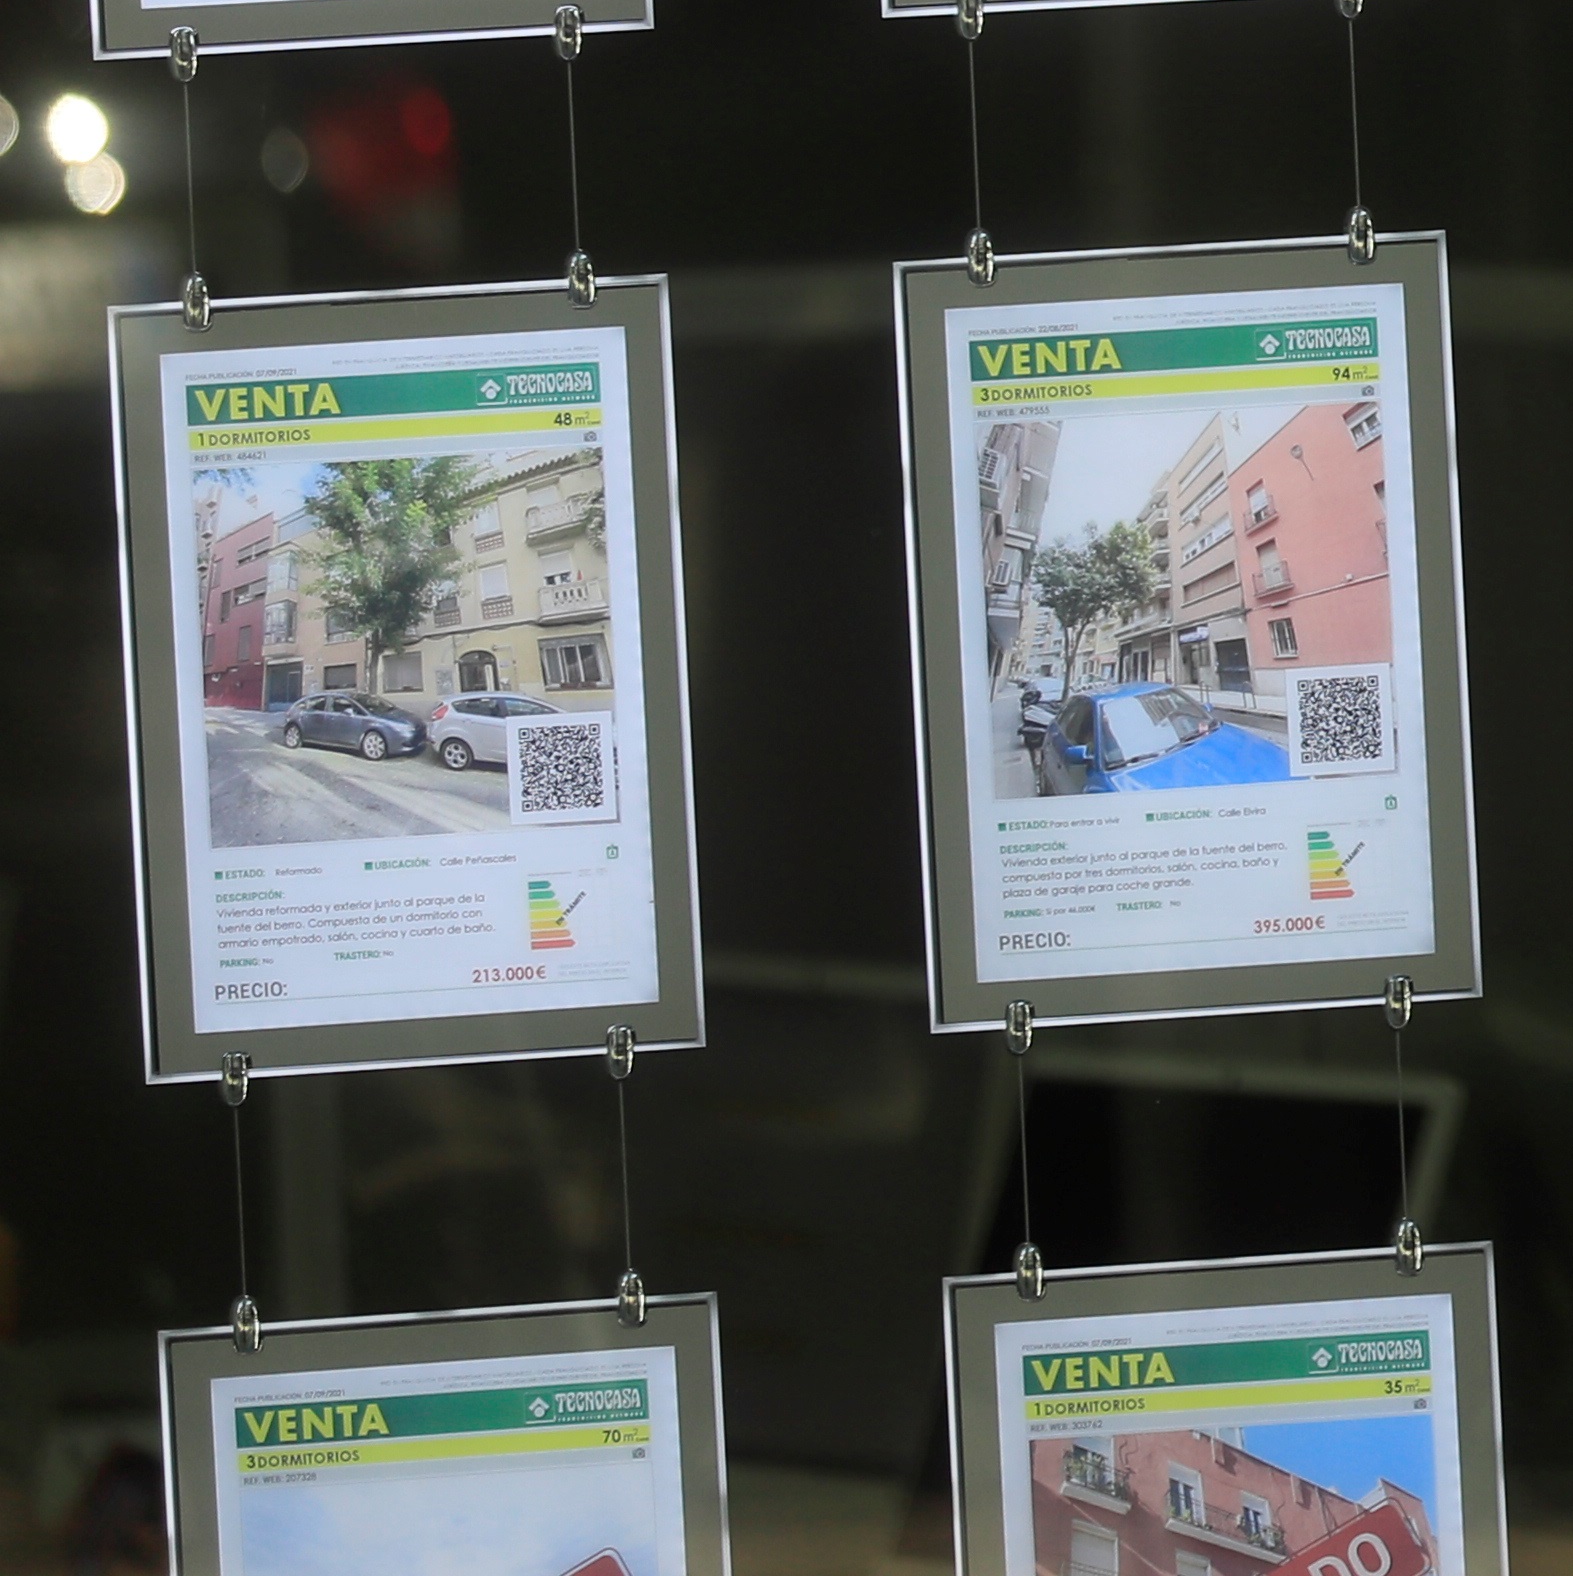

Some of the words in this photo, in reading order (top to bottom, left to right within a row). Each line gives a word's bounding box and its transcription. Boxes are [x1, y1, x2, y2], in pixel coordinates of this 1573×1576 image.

[1285, 325, 1372, 351] TECNOCASA
[977, 336, 1123, 377] VENTA
[506, 369, 594, 395] TECNOCASA
[195, 381, 341, 422] VENTA
[554, 409, 574, 429] 48
[999, 929, 1072, 951] PRECIO:
[214, 981, 289, 1000] PRECIO:
[1338, 1338, 1424, 1365] TECNOCASA
[1032, 1350, 1176, 1392] VENTA
[1384, 1377, 1405, 1397] 35
[555, 1387, 643, 1414] TECNOCASA
[244, 1400, 390, 1446] VENTA
[603, 1427, 624, 1446] 70
